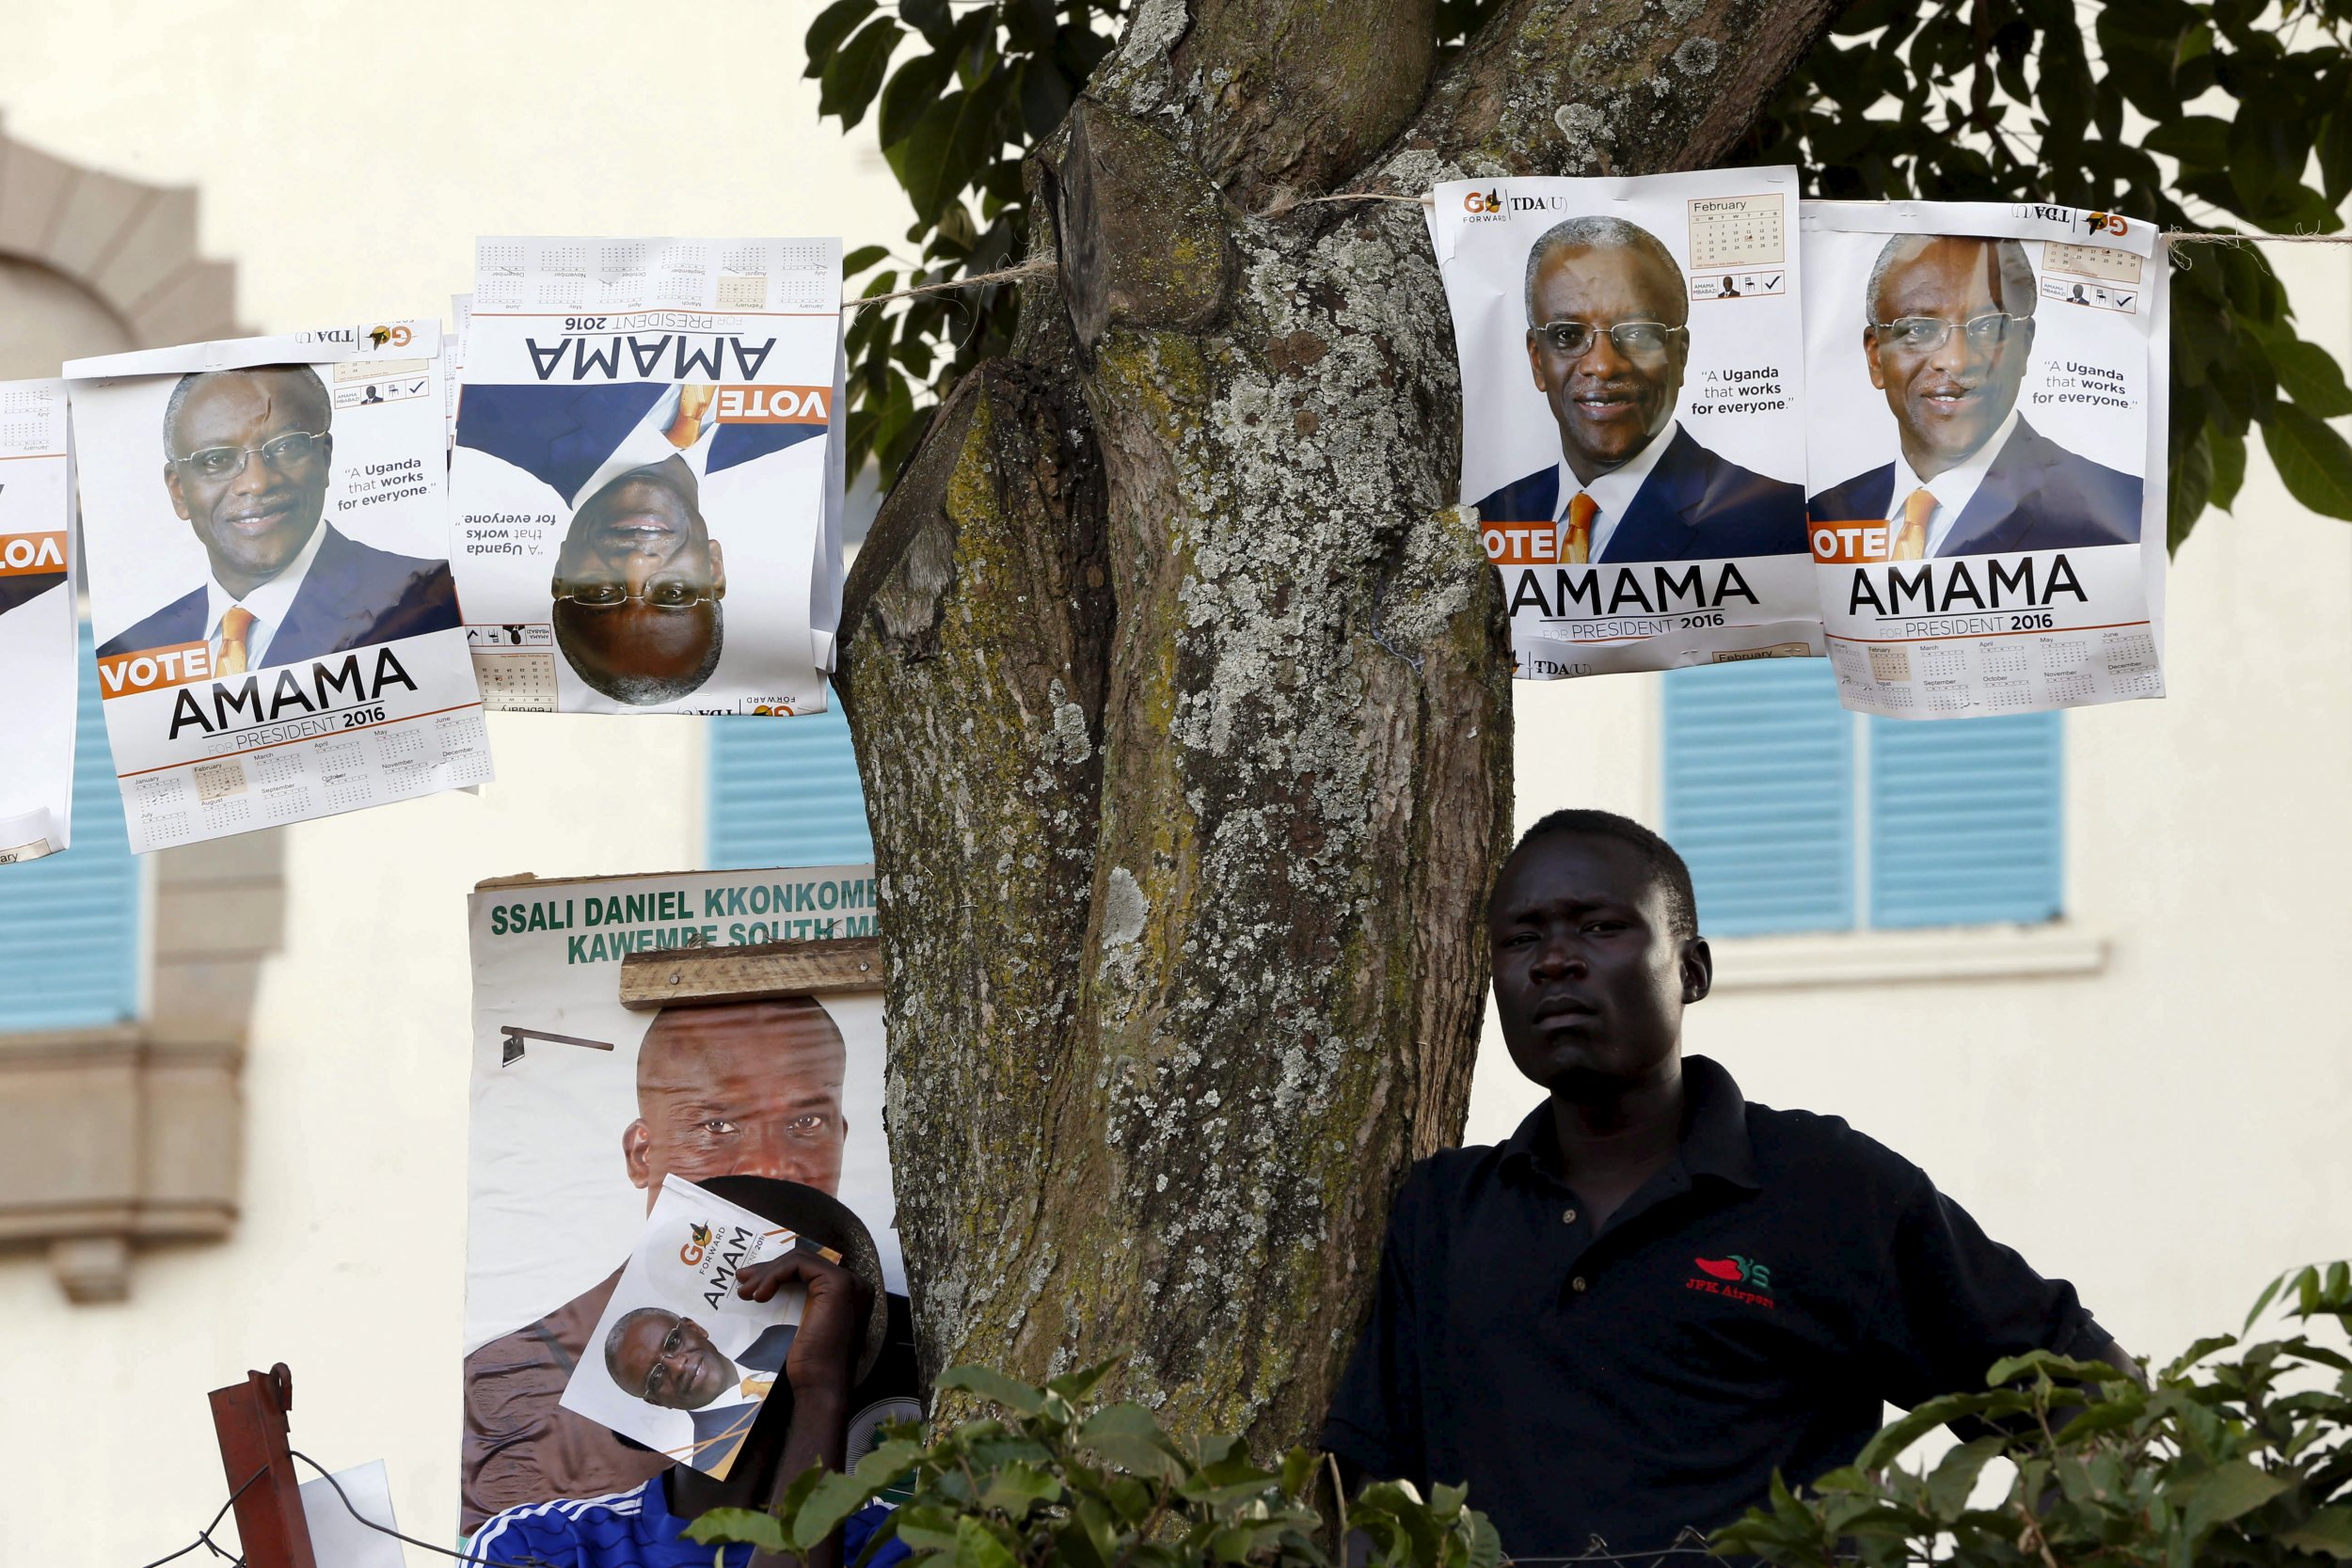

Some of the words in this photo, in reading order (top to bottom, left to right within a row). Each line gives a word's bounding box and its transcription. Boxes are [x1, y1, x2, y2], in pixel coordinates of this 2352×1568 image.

[1511, 197, 1568, 214] TDA(U)
[1693, 201, 1747, 213] February
[1463, 214, 1506, 224] FORWARD
[565, 317, 607, 330] 2016
[612, 312, 713, 329] PRESIDENT
[717, 316, 743, 325] FOR
[525, 335, 777, 381] AMAMA
[1723, 366, 1779, 383] Uganda
[2067, 361, 2124, 381] Uganda
[1705, 386, 1734, 399] that
[1738, 383, 1781, 397] works
[2046, 375, 2076, 388] that
[2081, 379, 2126, 395] works
[719, 390, 827, 417] VOTE
[1692, 403, 1713, 415] for
[2032, 392, 2054, 404] for
[365, 458, 421, 476] Uganda
[348, 480, 377, 494] that
[380, 472, 423, 487] works
[338, 499, 358, 512] for
[535, 514, 556, 526] for
[466, 530, 509, 541] works
[514, 529, 542, 540] that
[1483, 529, 1555, 559] OTE
[1812, 528, 1886, 559] OTE
[0, 537, 64, 569] VO
[467, 543, 522, 556] Uganda
[1508, 562, 1760, 617] AMAMA
[1849, 553, 2088, 616] AMAMA
[1543, 628, 1569, 639] FOR
[1572, 619, 1672, 639] PRESIDENT
[1680, 613, 1724, 629] 2016
[1880, 627, 1902, 639] FOR
[1905, 616, 2004, 638] PRESIDENT
[2010, 613, 2054, 630] 2016
[100, 647, 209, 692] VOTE
[1534, 660, 1592, 676] TDA(U)
[1923, 678, 1957, 687] September
[2108, 661, 2142, 670] December
[168, 647, 419, 740] AMAMA
[208, 742, 233, 754] FOR
[235, 716, 336, 751] PRESIDENT
[342, 706, 386, 728] 2016
[135, 775, 160, 785] January
[194, 763, 222, 772] February
[314, 740, 329, 749] April
[435, 716, 451, 724] June
[200, 798, 223, 806] August
[261, 783, 295, 794] September
[381, 758, 414, 769] November
[442, 746, 474, 757] December
[491, 900, 573, 936] SSALI
[584, 891, 693, 927] DANIEL
[729, 917, 834, 946] SOUTH
[699, 1227, 725, 1275] FORWARD
[704, 1226, 754, 1311] AMAM
[1686, 1278, 1719, 1293] JFK
[1722, 1285, 1775, 1309] Airport
